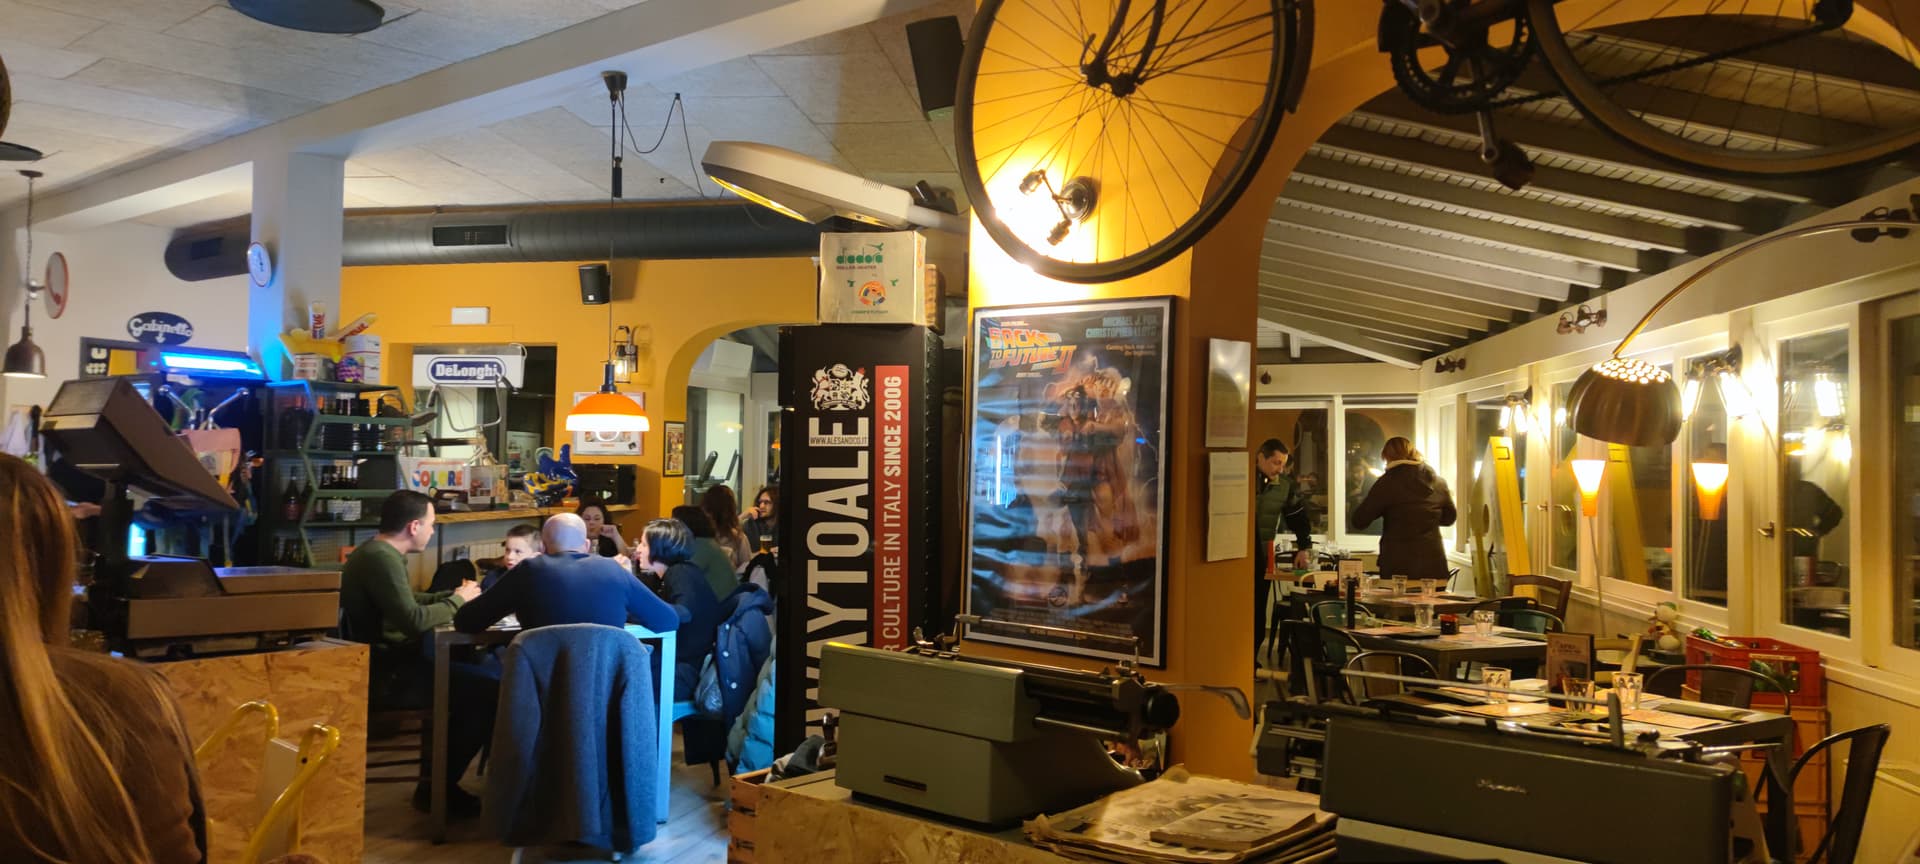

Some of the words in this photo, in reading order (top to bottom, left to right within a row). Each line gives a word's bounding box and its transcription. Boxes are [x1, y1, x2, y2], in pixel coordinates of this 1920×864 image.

[836, 248, 883, 264] diadora
[129, 318, 193, 337] Gabinetto
[988, 327, 1053, 349] BACK
[1001, 346, 1059, 367] FUTURE
[883, 376, 902, 421] 2006
[883, 425, 902, 477] SINCE
[883, 480, 901, 528] ITALY
[883, 533, 900, 551] IN
[882, 555, 900, 640] CULTURE
